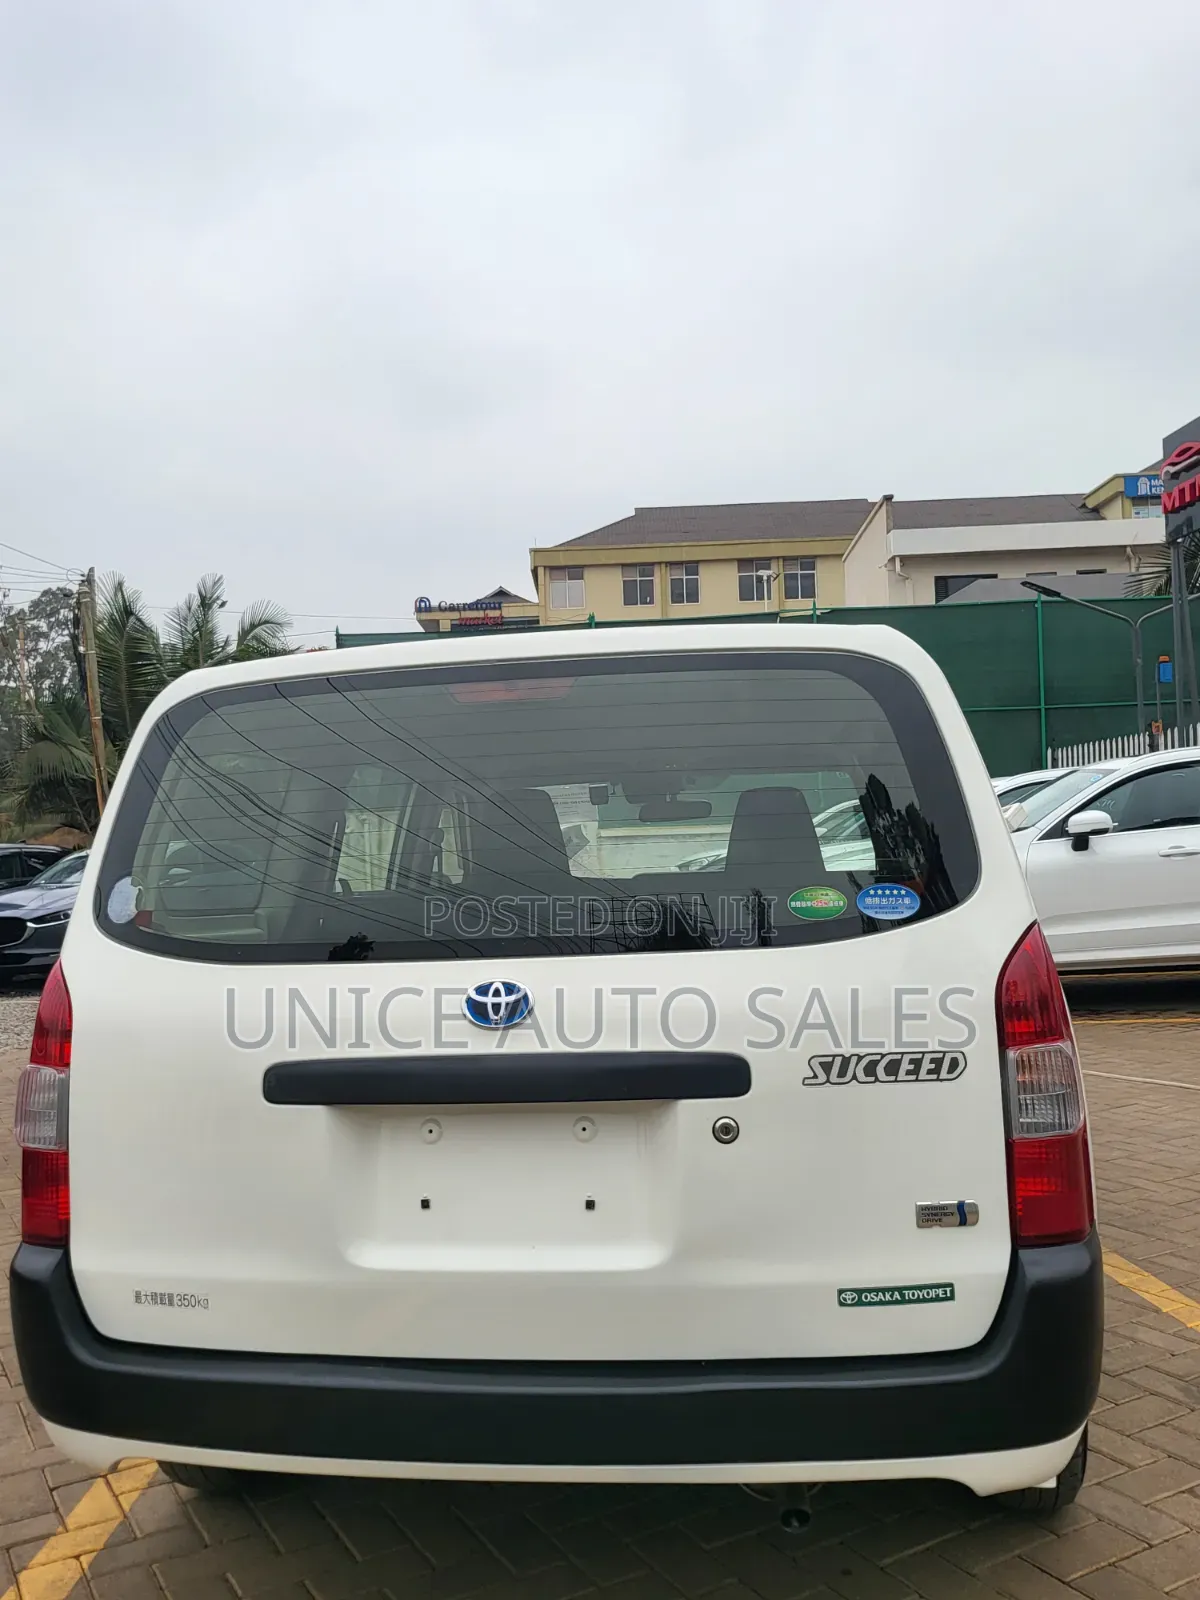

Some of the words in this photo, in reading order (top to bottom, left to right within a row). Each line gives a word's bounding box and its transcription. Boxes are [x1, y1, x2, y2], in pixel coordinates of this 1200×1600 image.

[802, 1051, 967, 1087] SUCCEED
[861, 1291, 901, 1302] OSAKA
[902, 1287, 952, 1300] TOYOPET
